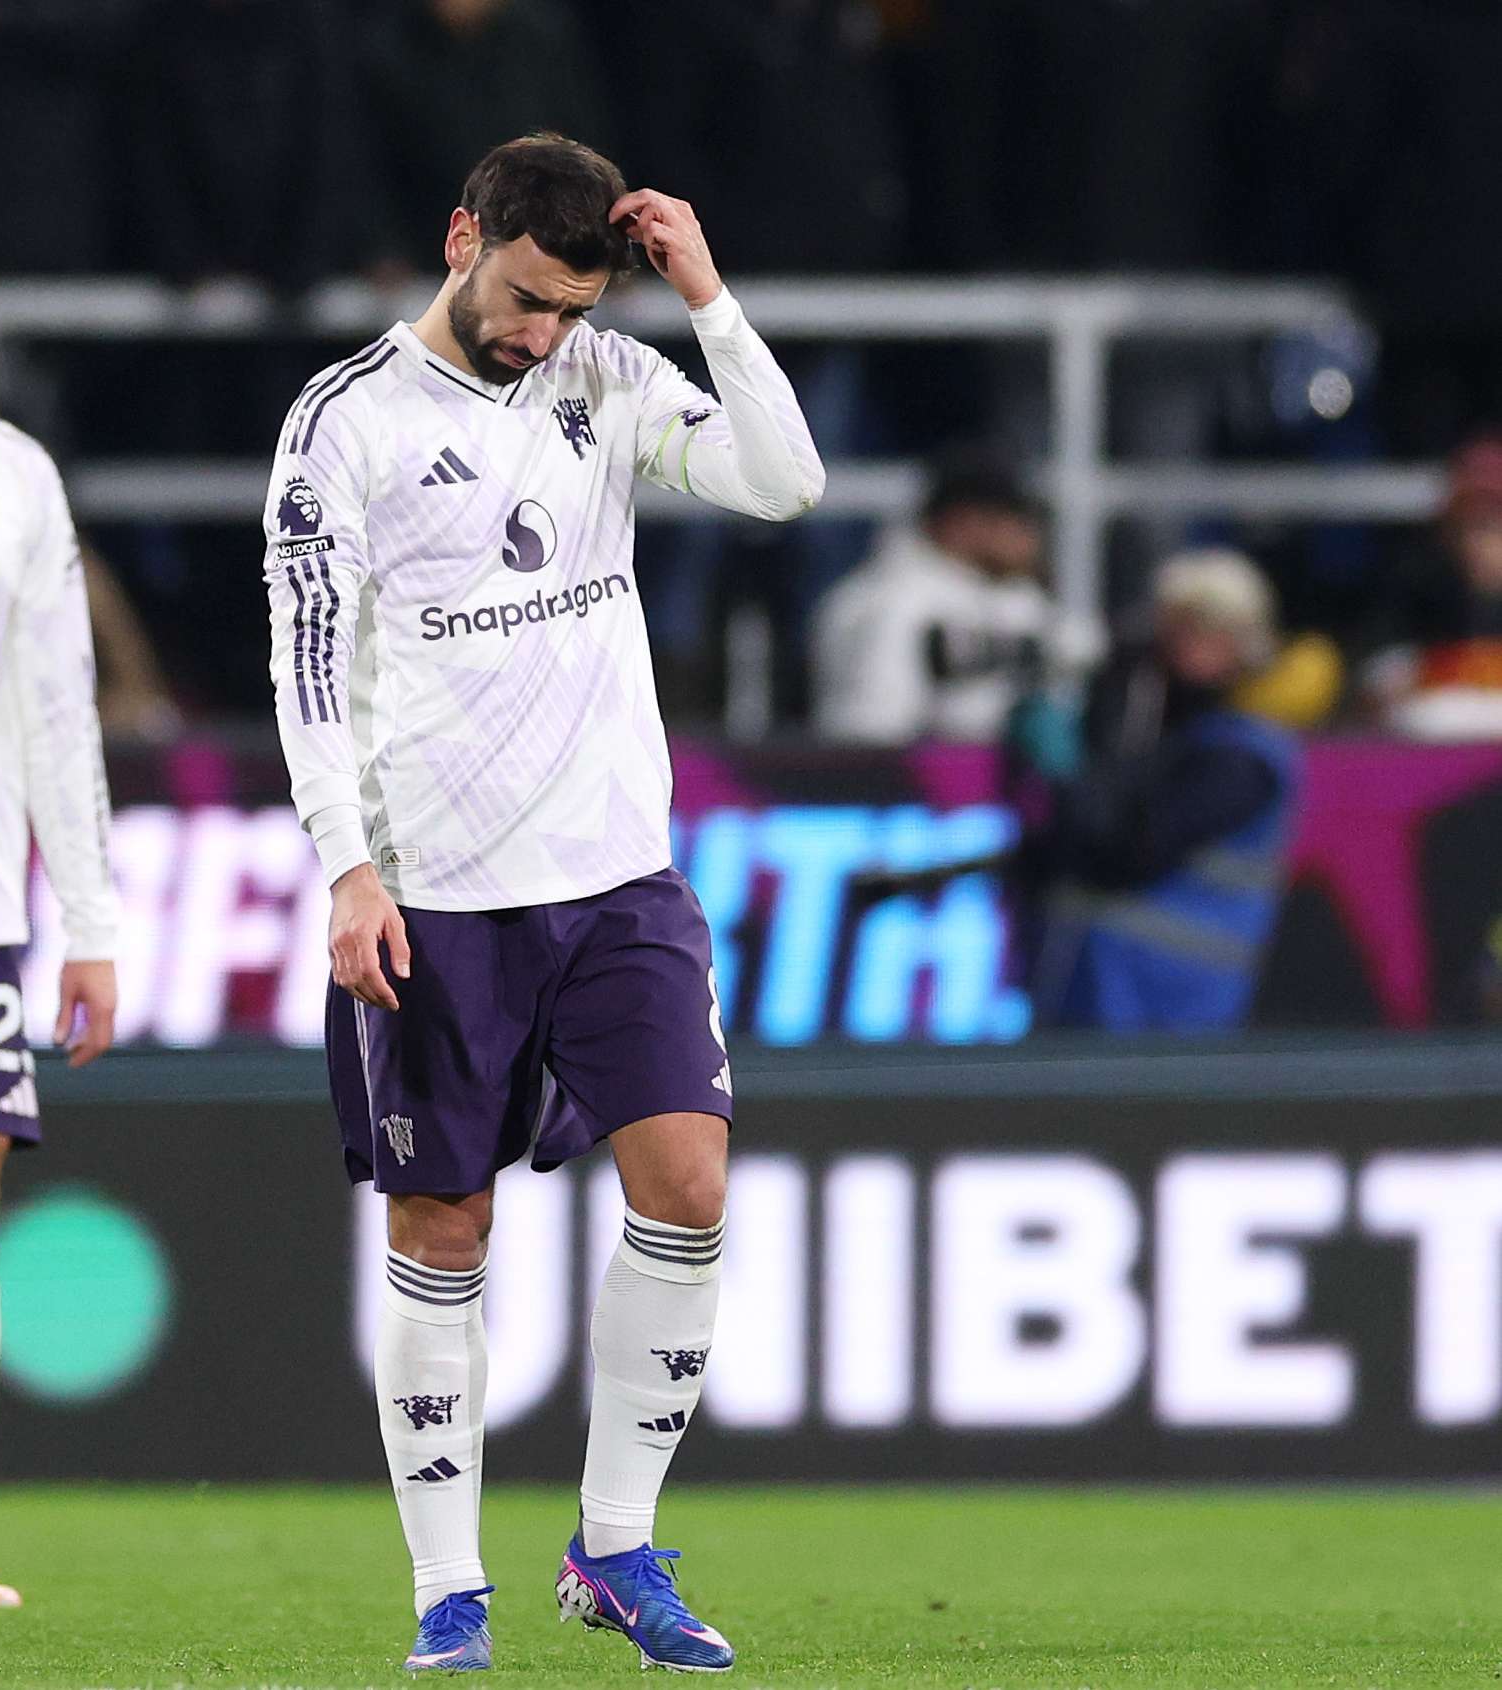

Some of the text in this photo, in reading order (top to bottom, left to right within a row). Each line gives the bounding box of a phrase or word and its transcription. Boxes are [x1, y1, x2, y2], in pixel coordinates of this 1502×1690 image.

[277, 539, 329, 557] No room
[420, 574, 629, 641] Snapdragon
